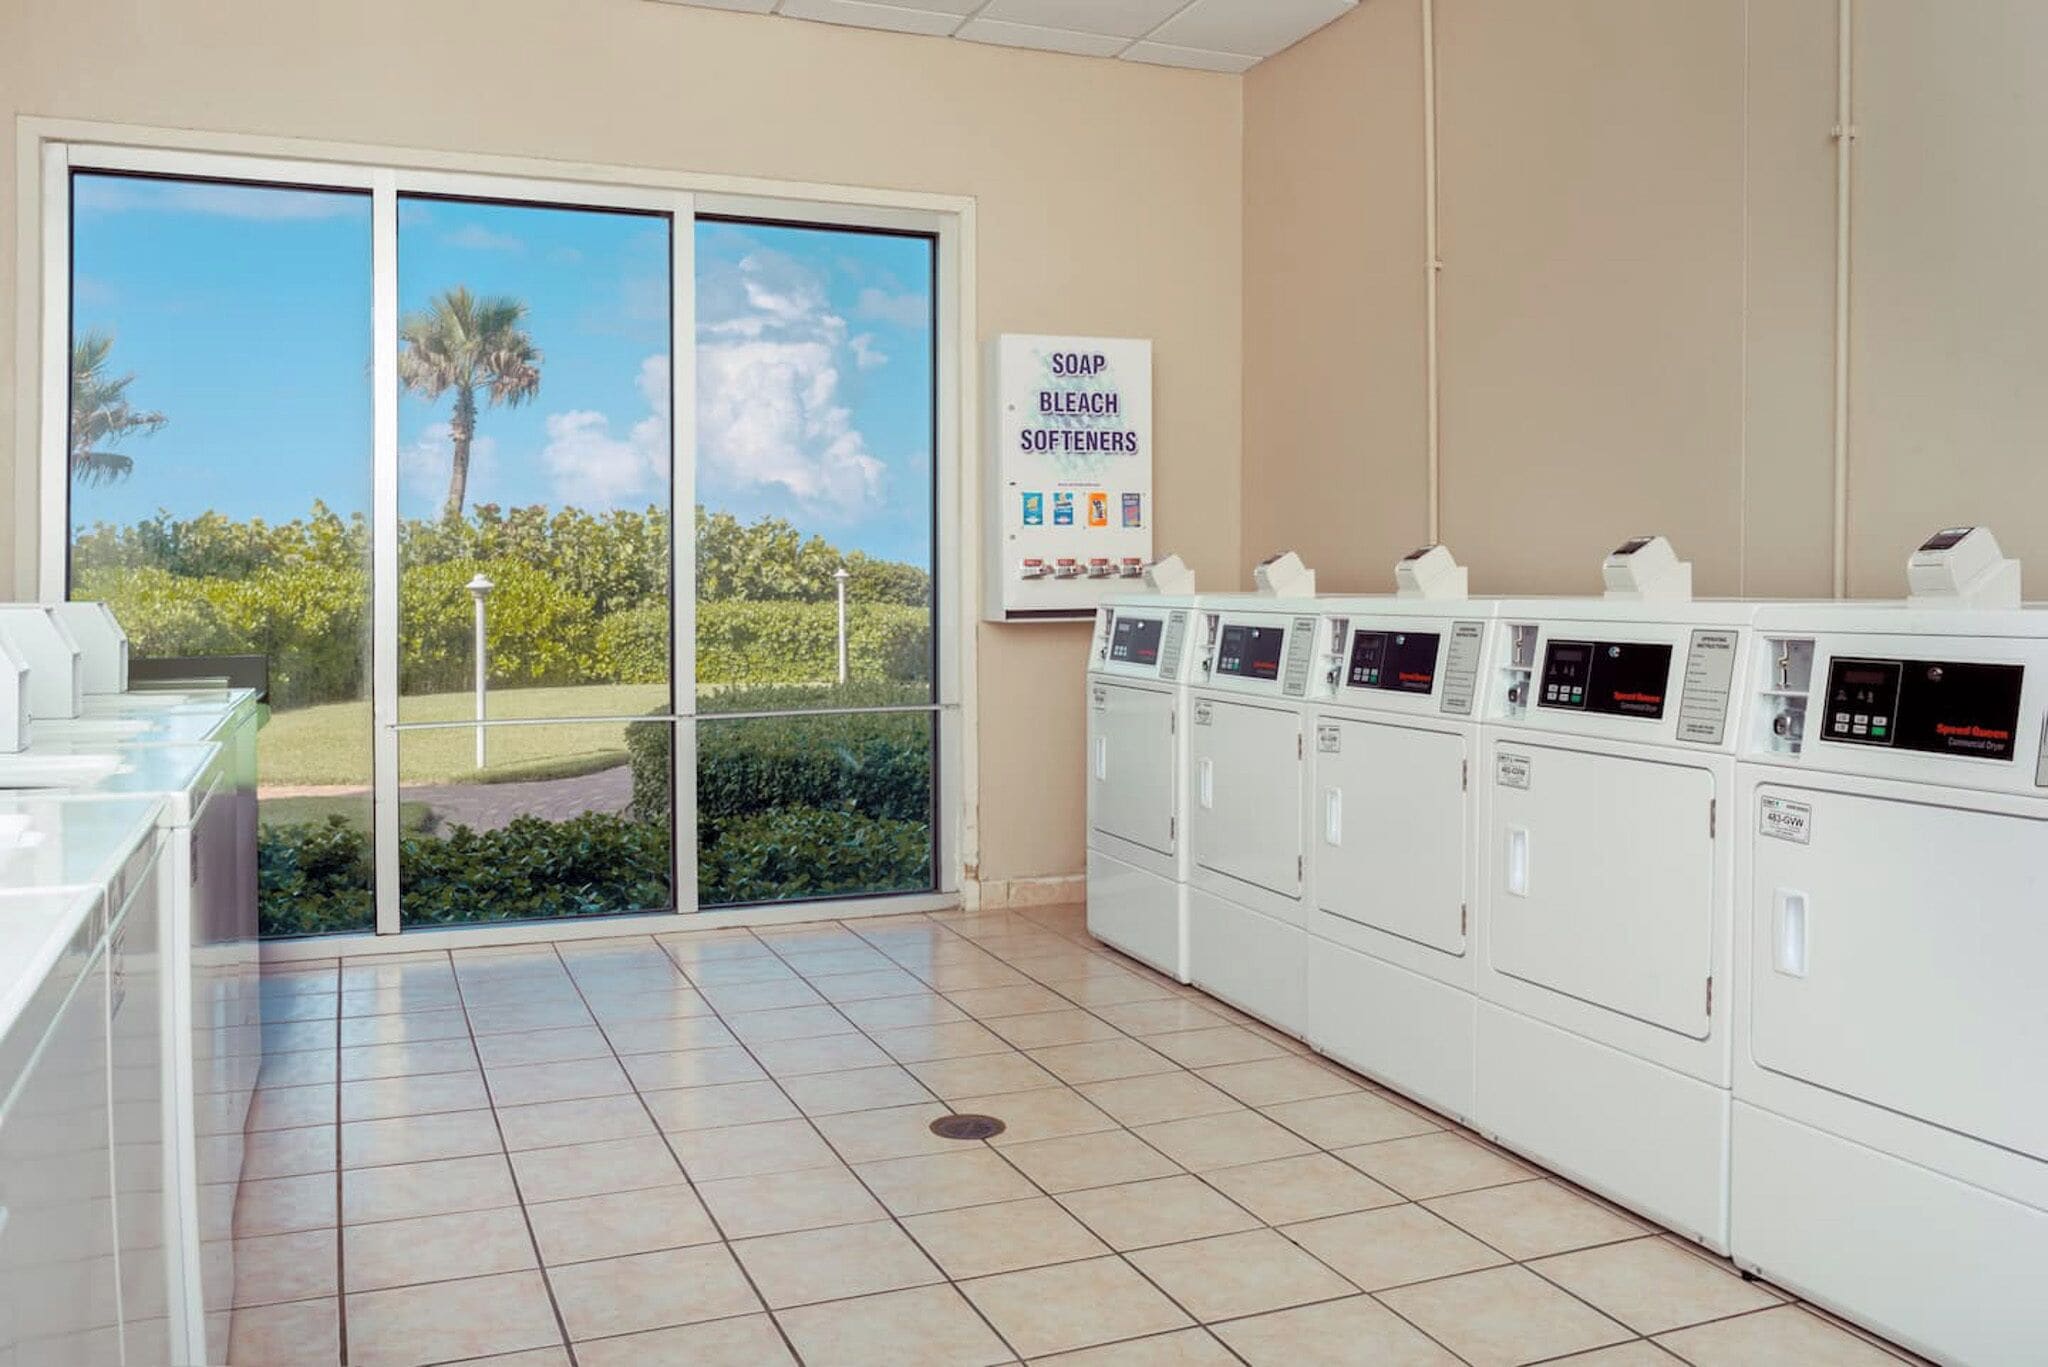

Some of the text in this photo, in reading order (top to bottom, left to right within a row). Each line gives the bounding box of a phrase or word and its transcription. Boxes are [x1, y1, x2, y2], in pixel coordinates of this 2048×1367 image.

[1052, 353, 1106, 375] SOAP
[1040, 391, 1119, 414] BLEACH
[1021, 429, 1137, 452] SOFTENERS
[1936, 723, 2008, 740] Speed Queen
[1948, 737, 2005, 752] Commercial Dryer
